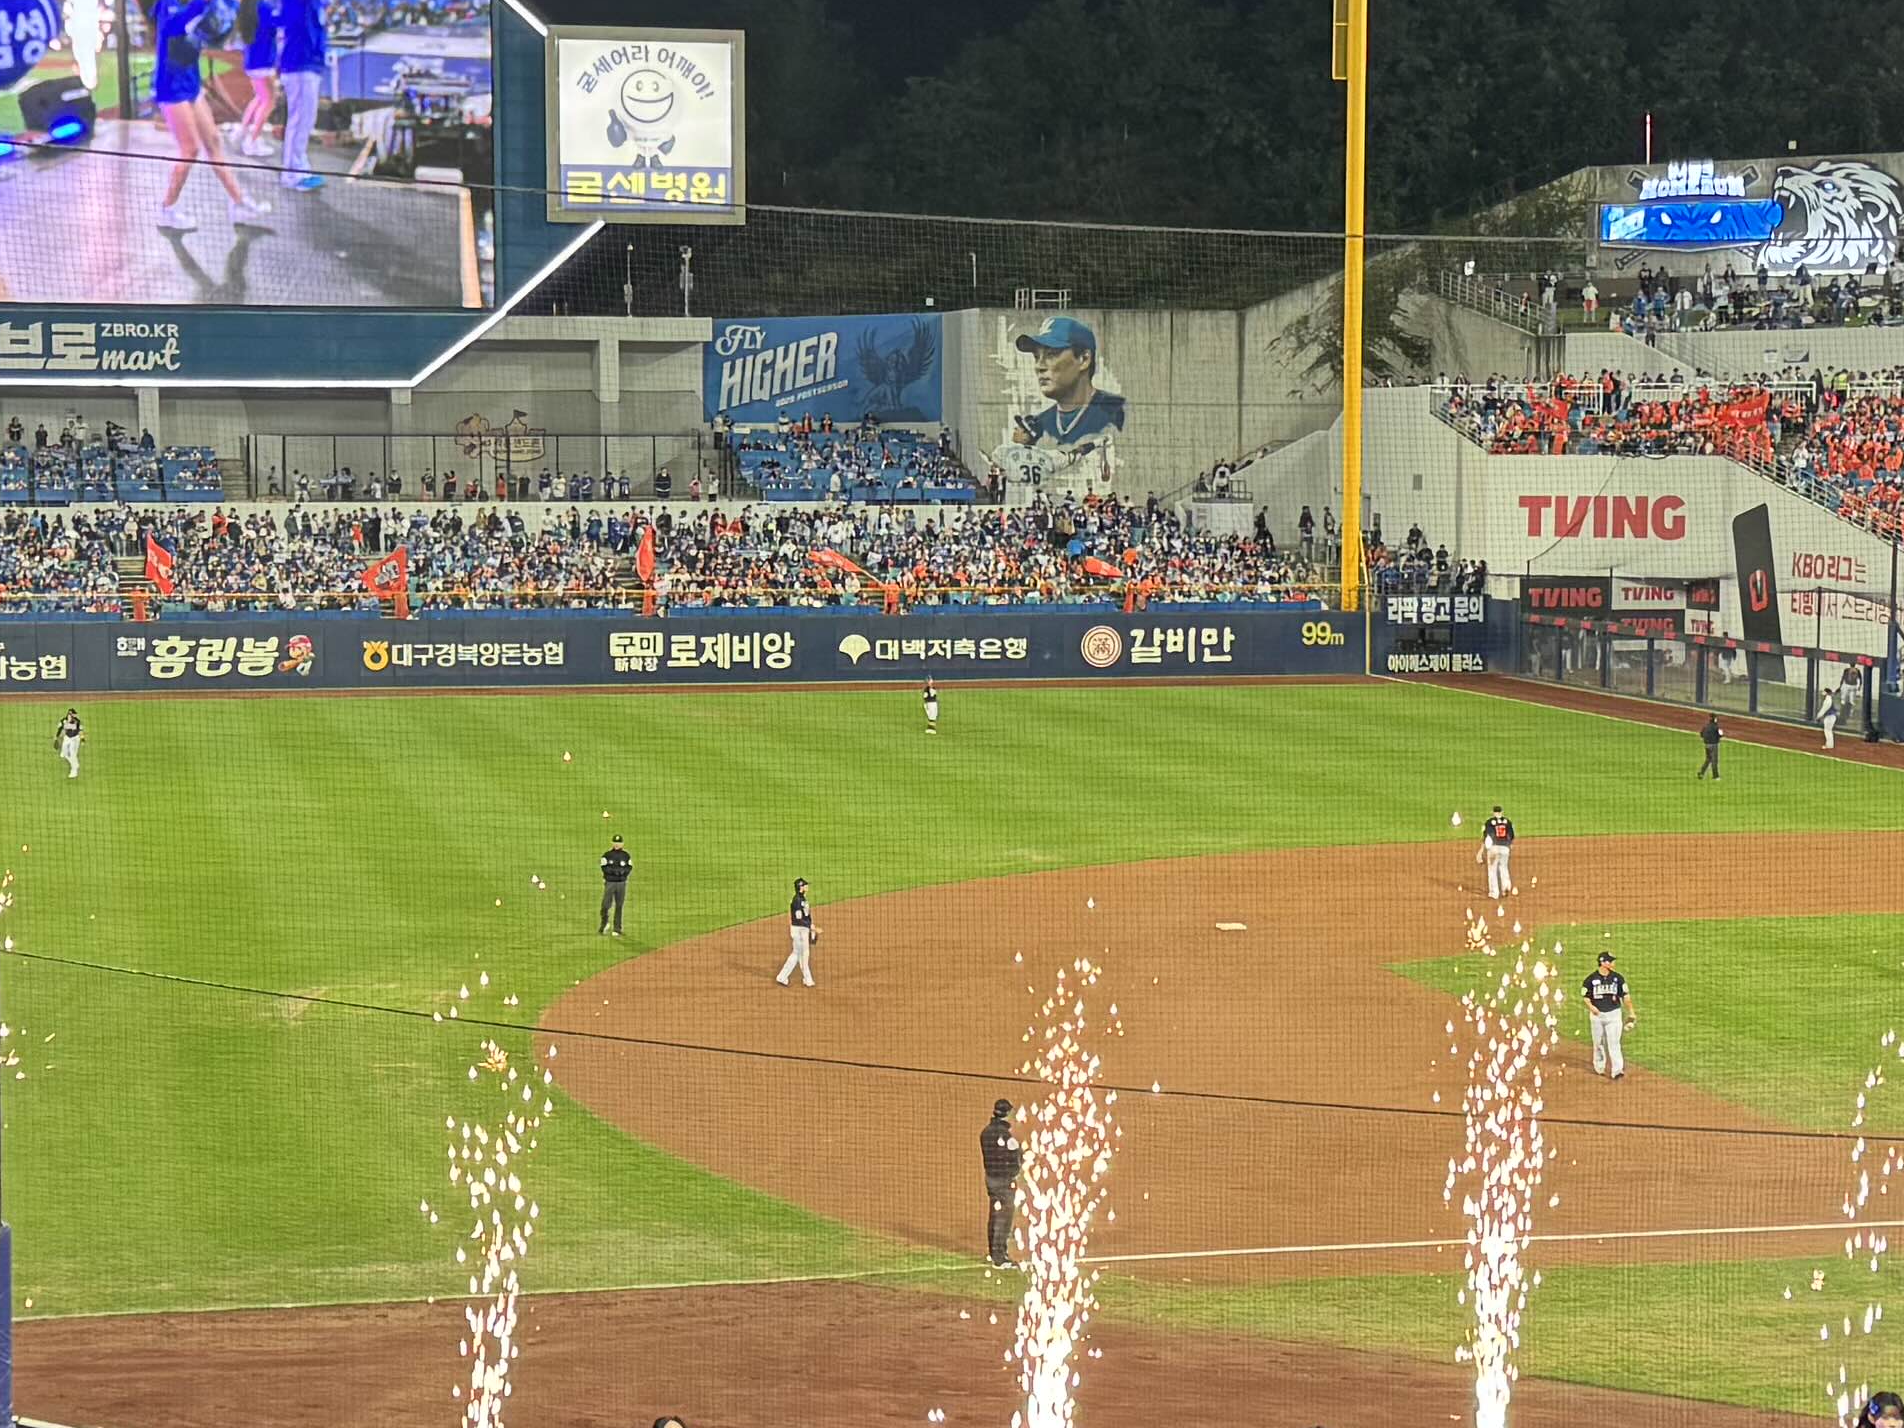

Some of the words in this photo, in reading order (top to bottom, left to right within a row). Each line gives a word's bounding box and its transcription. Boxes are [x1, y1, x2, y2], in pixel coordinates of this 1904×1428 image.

[100, 323, 179, 339] ZBRO.KR
[714, 324, 767, 356] FLY
[101, 337, 181, 372] mart
[718, 331, 839, 412] HIGHER
[1019, 464, 1041, 485] 36
[1518, 494, 1686, 541] TVING
[1791, 551, 1825, 580] KBO
[1827, 555, 1867, 584] 리그는
[1528, 586, 1603, 609] TVING
[1621, 586, 1675, 602] TVING
[1421, 596, 1451, 624] 광고
[1454, 595, 1484, 623] 문의
[615, 634, 658, 655] 구미
[1129, 626, 1236, 664] 갈비만
[1301, 620, 1345, 646] 99m
[146, 635, 280, 679] 홈런볼
[391, 641, 564, 667] 대구경북양돈농협
[666, 631, 796, 670] 로제비앙
[874, 637, 1028, 661] 대백저축은행
